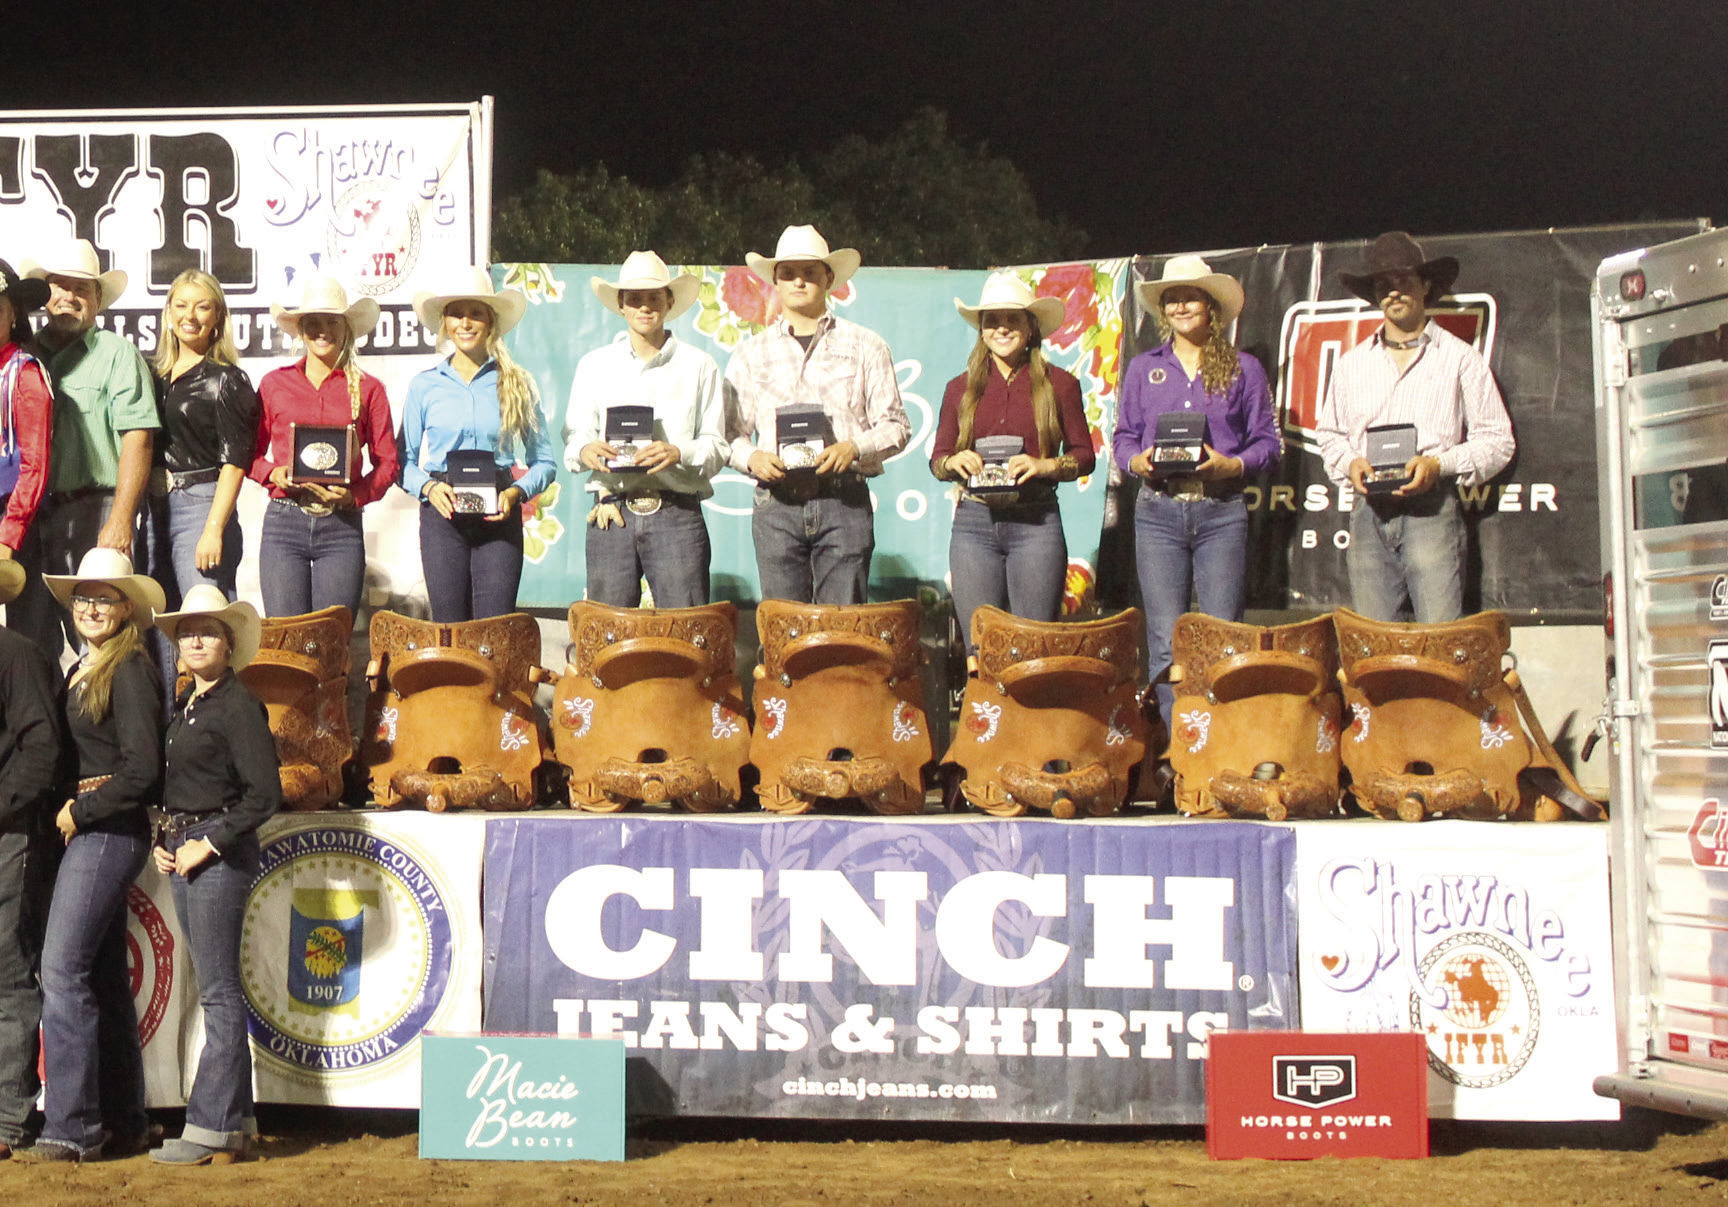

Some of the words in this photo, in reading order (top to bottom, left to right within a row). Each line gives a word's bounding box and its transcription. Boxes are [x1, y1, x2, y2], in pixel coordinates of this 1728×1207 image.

[262, 127, 455, 237] Shawnee
[1243, 484, 1354, 512] ORSE
[1458, 483, 1559, 512] WER
[260, 831, 376, 869] AWATOMIE
[379, 845, 444, 912] COUNTY
[544, 864, 1235, 991] CINCH
[1313, 856, 1592, 1010] Shawnee
[306, 984, 343, 1001] 1907
[552, 998, 810, 1051] JEANS
[831, 1003, 895, 1053] &
[917, 1004, 1229, 1060] SHIRTS
[270, 1035, 399, 1069] OKLAHOMA
[1444, 1033, 1508, 1065] IFYR
[466, 1045, 578, 1100] Macie
[782, 1077, 997, 1101] cinchjeans.com
[1286, 1065, 1344, 1096] HP
[465, 1098, 577, 1149] Bean
[1240, 1115, 1314, 1128] HORSE
[1320, 1115, 1393, 1128] POWER
[1286, 1131, 1348, 1141] BOOTS
[511, 1138, 575, 1148] BOOTS
